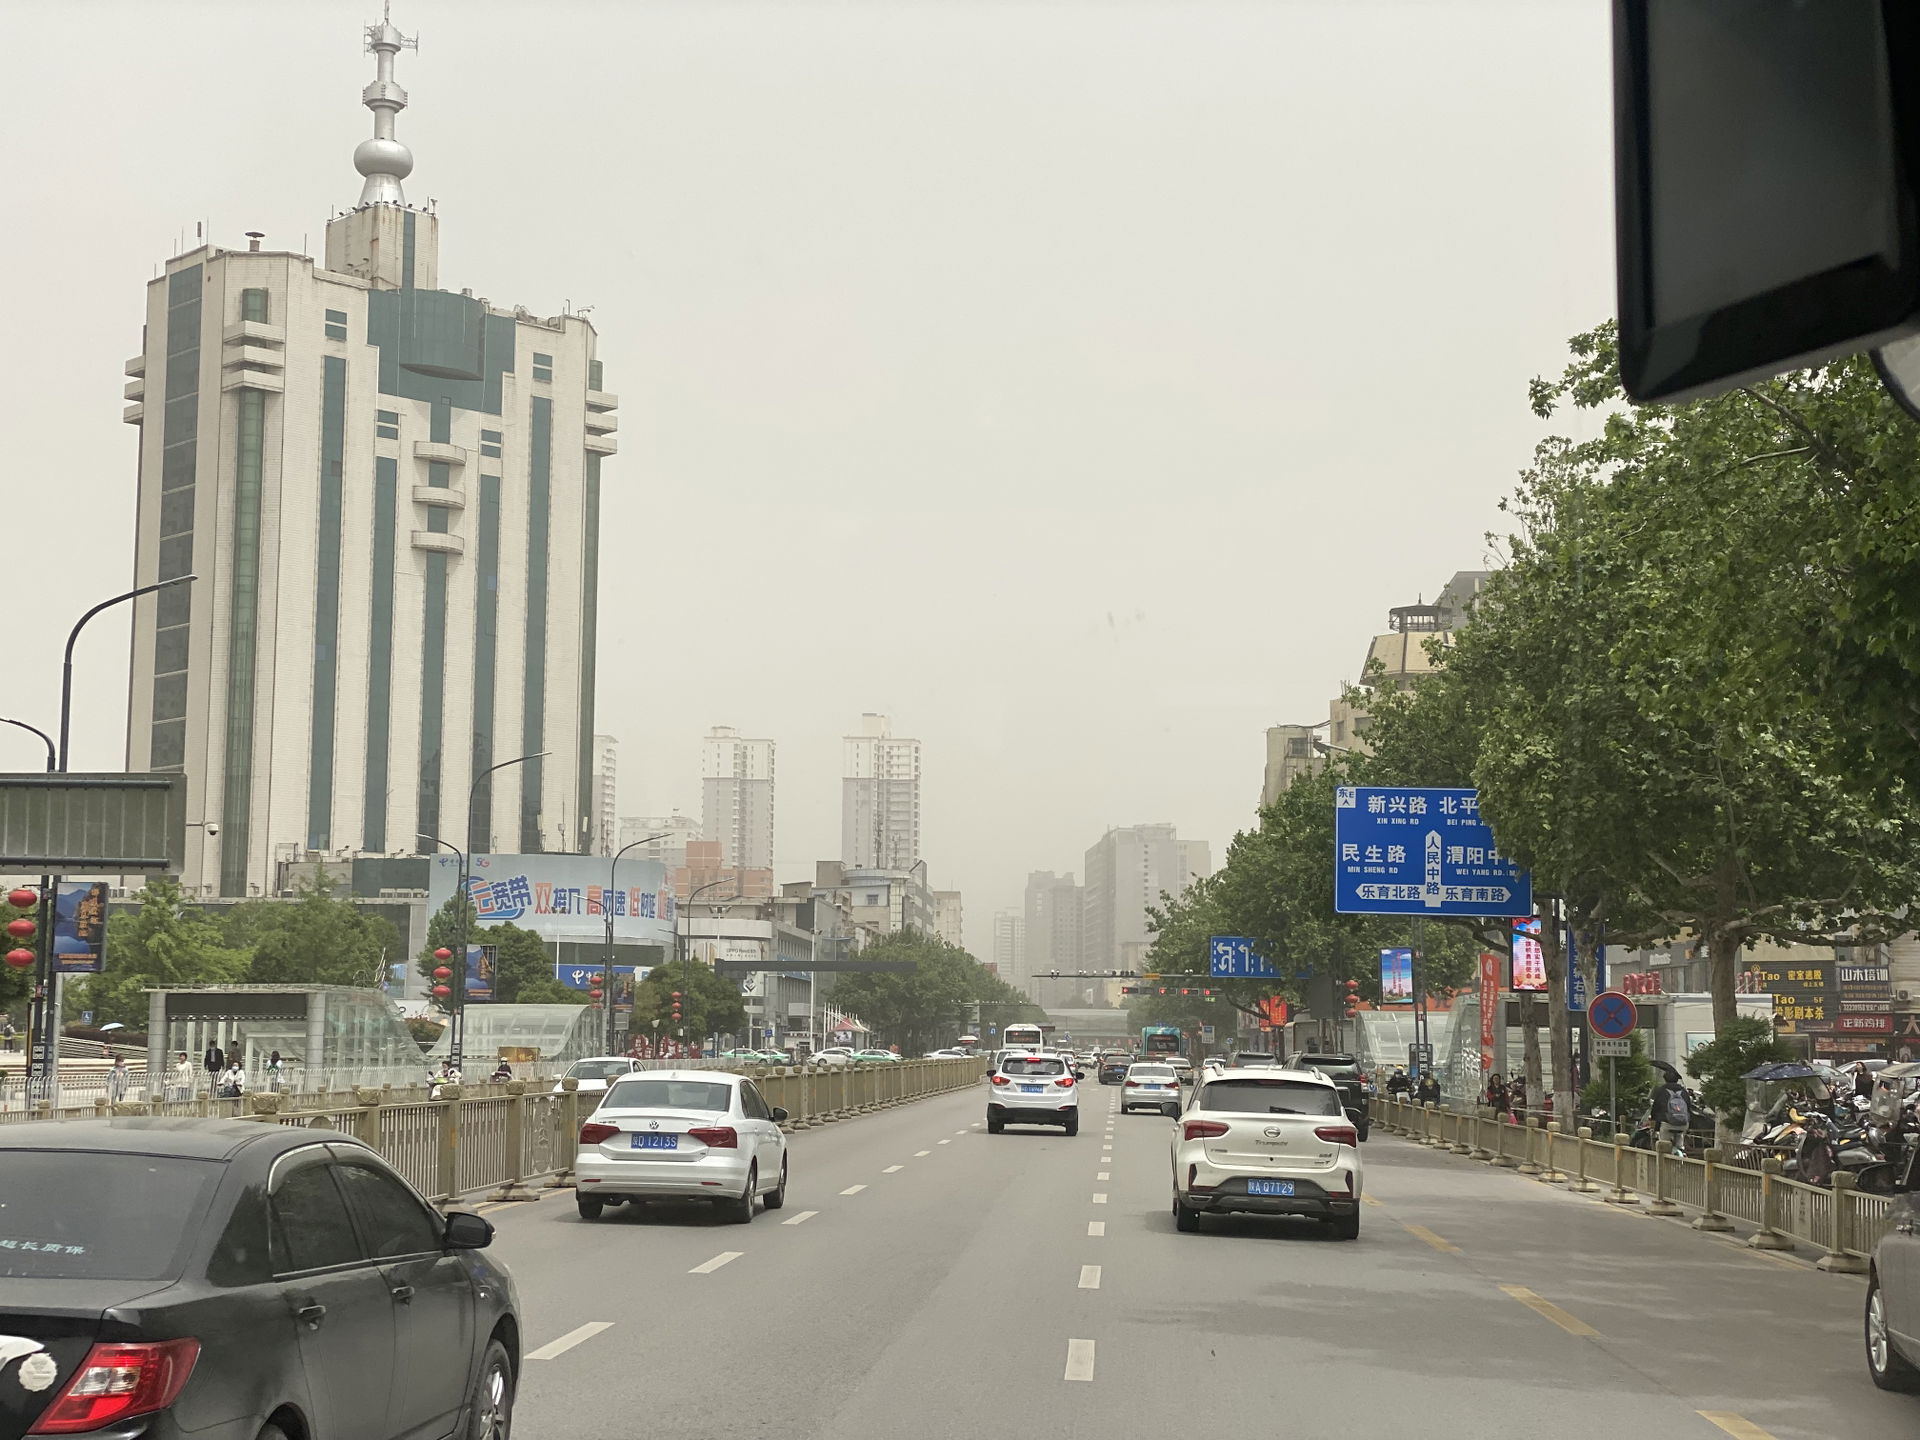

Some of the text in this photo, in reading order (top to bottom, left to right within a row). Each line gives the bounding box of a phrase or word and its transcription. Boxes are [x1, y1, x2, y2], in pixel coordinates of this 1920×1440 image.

[1338, 788, 1348, 798] 东
[1368, 795, 1427, 814] 新兴路
[1376, 817, 1388, 825] XIN
[1391, 817, 1406, 825] XING
[1342, 843, 1406, 863] 民生路
[1363, 866, 1386, 874] SHENG
[1426, 836, 1440, 895] 人民中路
[1456, 868, 1469, 876] WEI
[1472, 868, 1490, 876] YANG
[1362, 885, 1420, 899] 乐育北路
[1445, 887, 1505, 902] 乐育南路
[1760, 971, 1781, 981] Tao
[1841, 968, 1889, 982] 山木培训
[1774, 994, 1796, 1005] Tao
[1843, 1018, 1886, 1028] 正新鸡排
